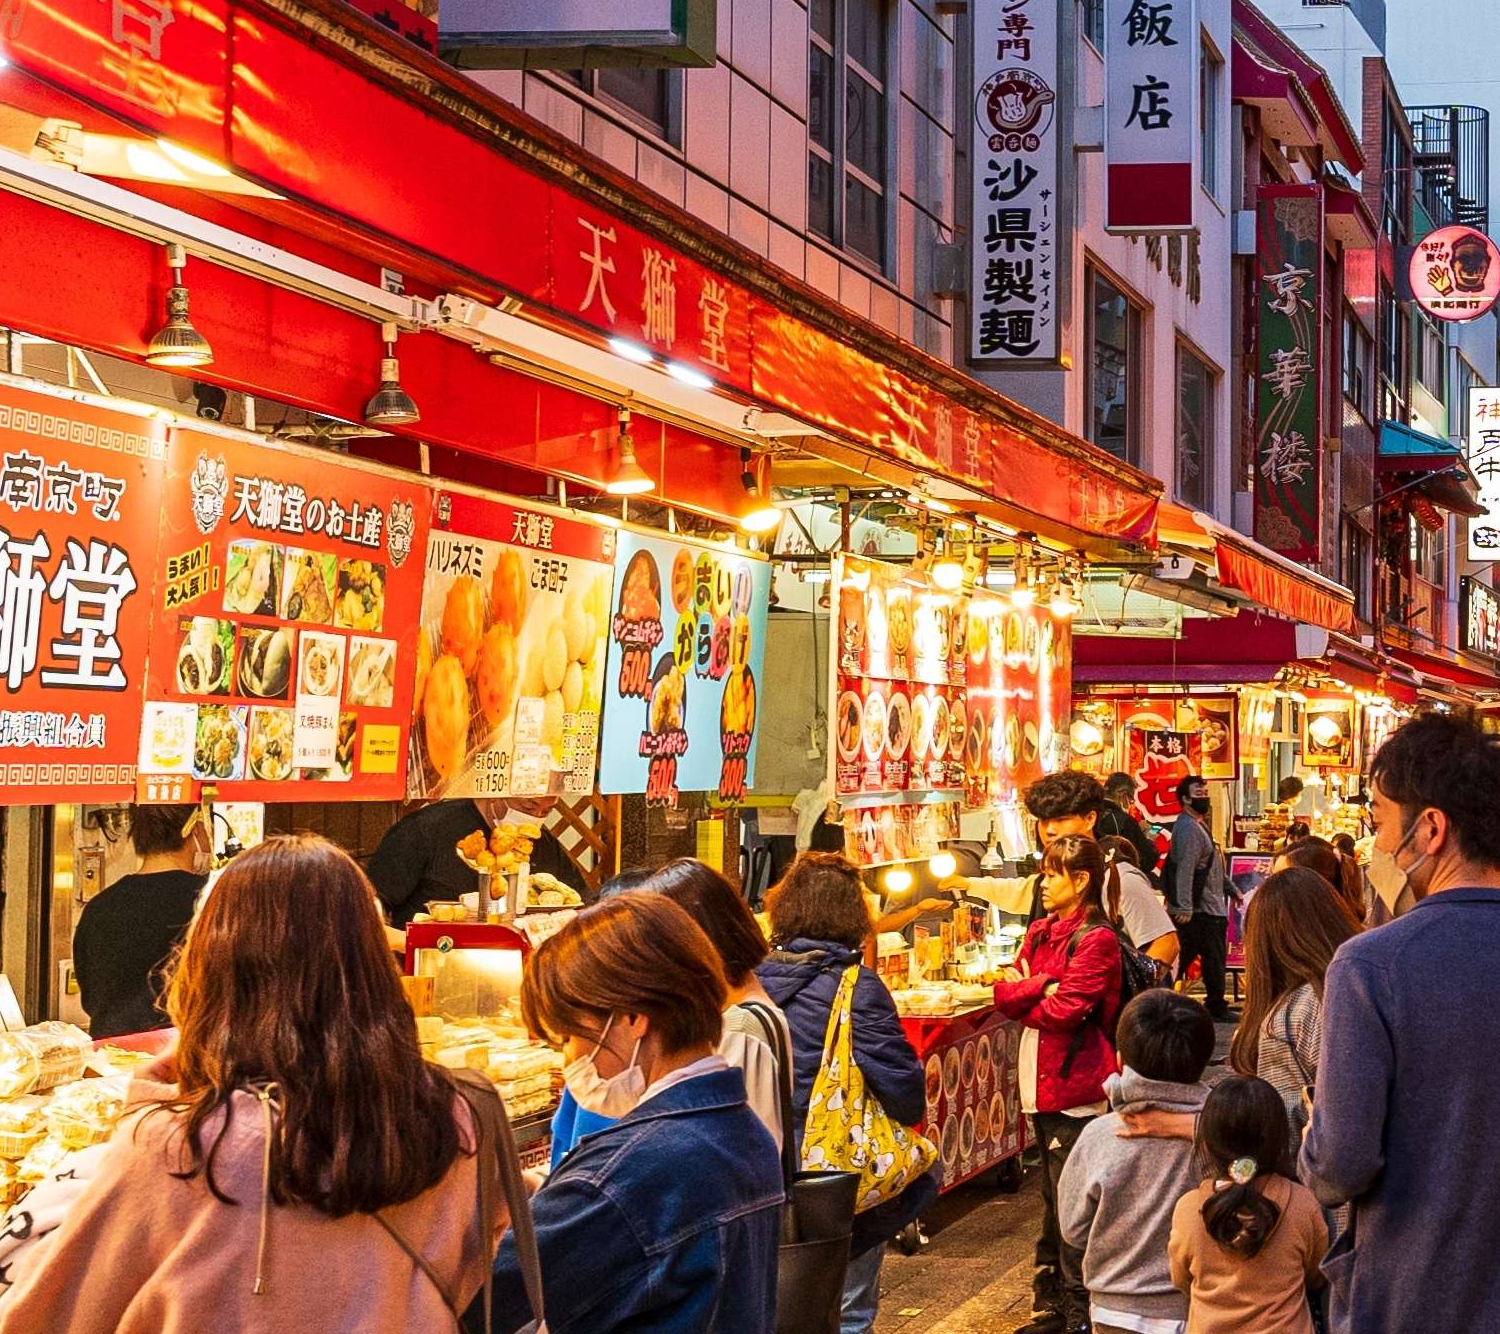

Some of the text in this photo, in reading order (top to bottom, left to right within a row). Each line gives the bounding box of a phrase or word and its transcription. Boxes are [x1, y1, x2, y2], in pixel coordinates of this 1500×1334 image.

[578, 216, 731, 375] 天獅堂
[230, 476, 384, 547] 天獅堂のお土産
[428, 539, 484, 579] ハリネズミ
[1149, 734, 1183, 755] 本格
